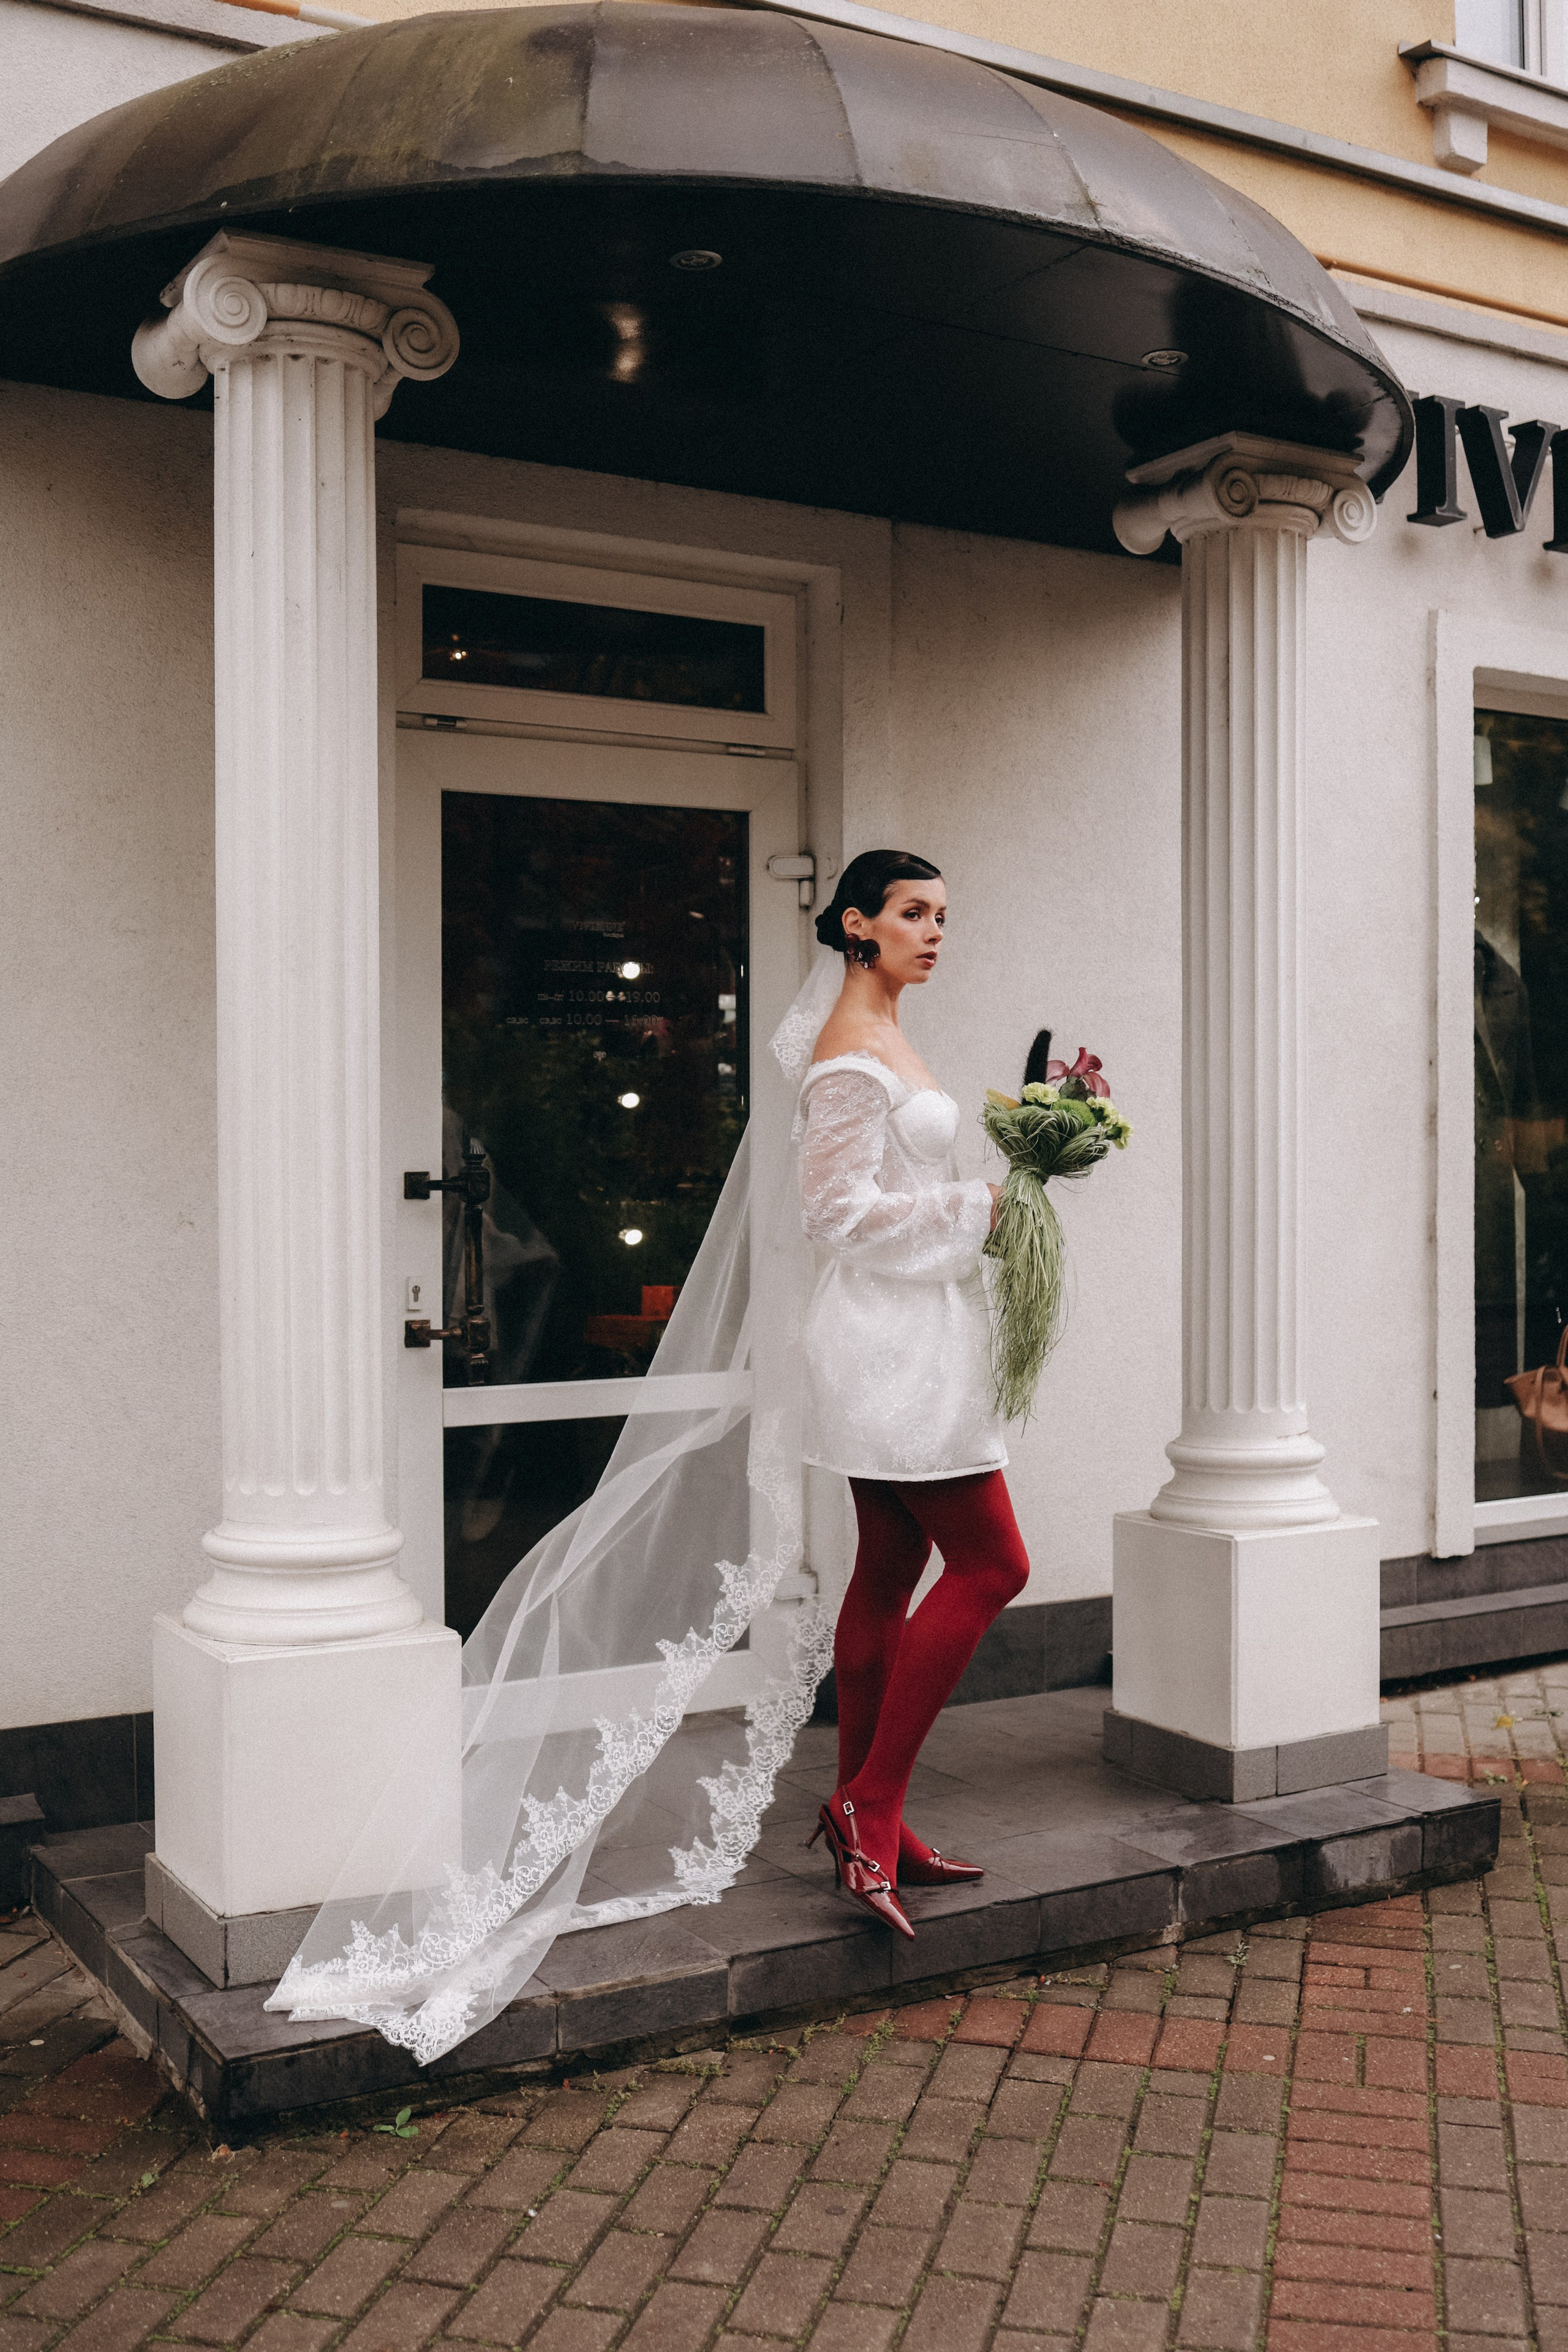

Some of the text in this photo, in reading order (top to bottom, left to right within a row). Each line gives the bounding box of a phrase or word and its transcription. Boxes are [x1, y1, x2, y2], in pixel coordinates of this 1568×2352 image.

[1406, 389, 1568, 554] IV
[597, 961, 654, 974] РАБЫ:
[568, 990, 604, 1001] 10.00
[626, 991, 660, 1003] 19.00
[566, 1013, 602, 1025] 10.00
